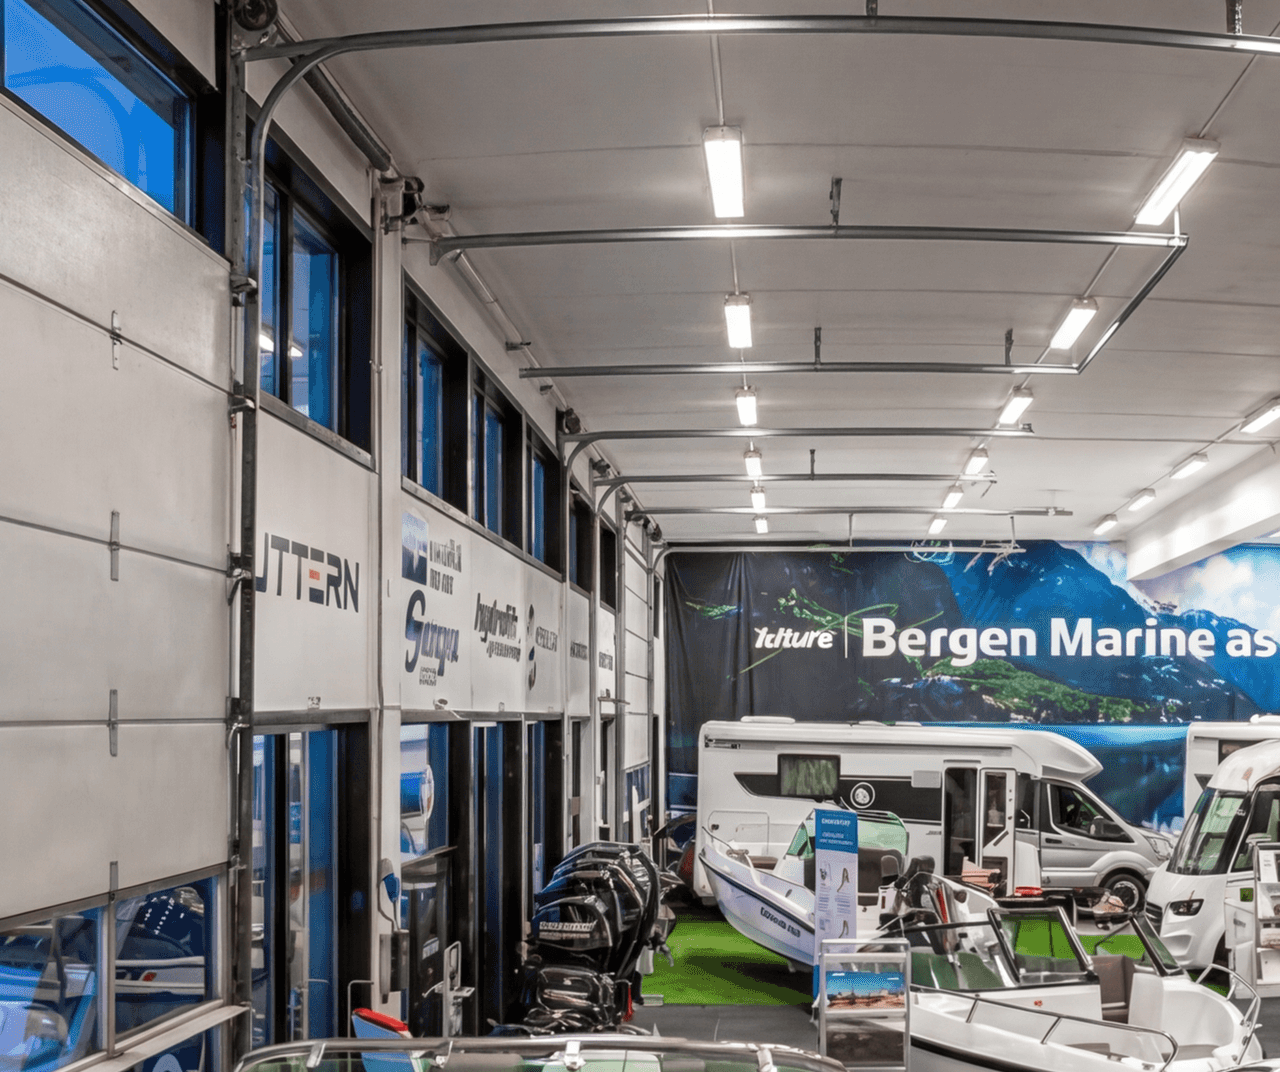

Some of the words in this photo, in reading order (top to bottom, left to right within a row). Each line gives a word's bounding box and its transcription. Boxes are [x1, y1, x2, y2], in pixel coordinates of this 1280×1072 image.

[862, 617, 1037, 667] Bergen
[1051, 617, 1215, 657] Marine
[1225, 628, 1277, 657] as
